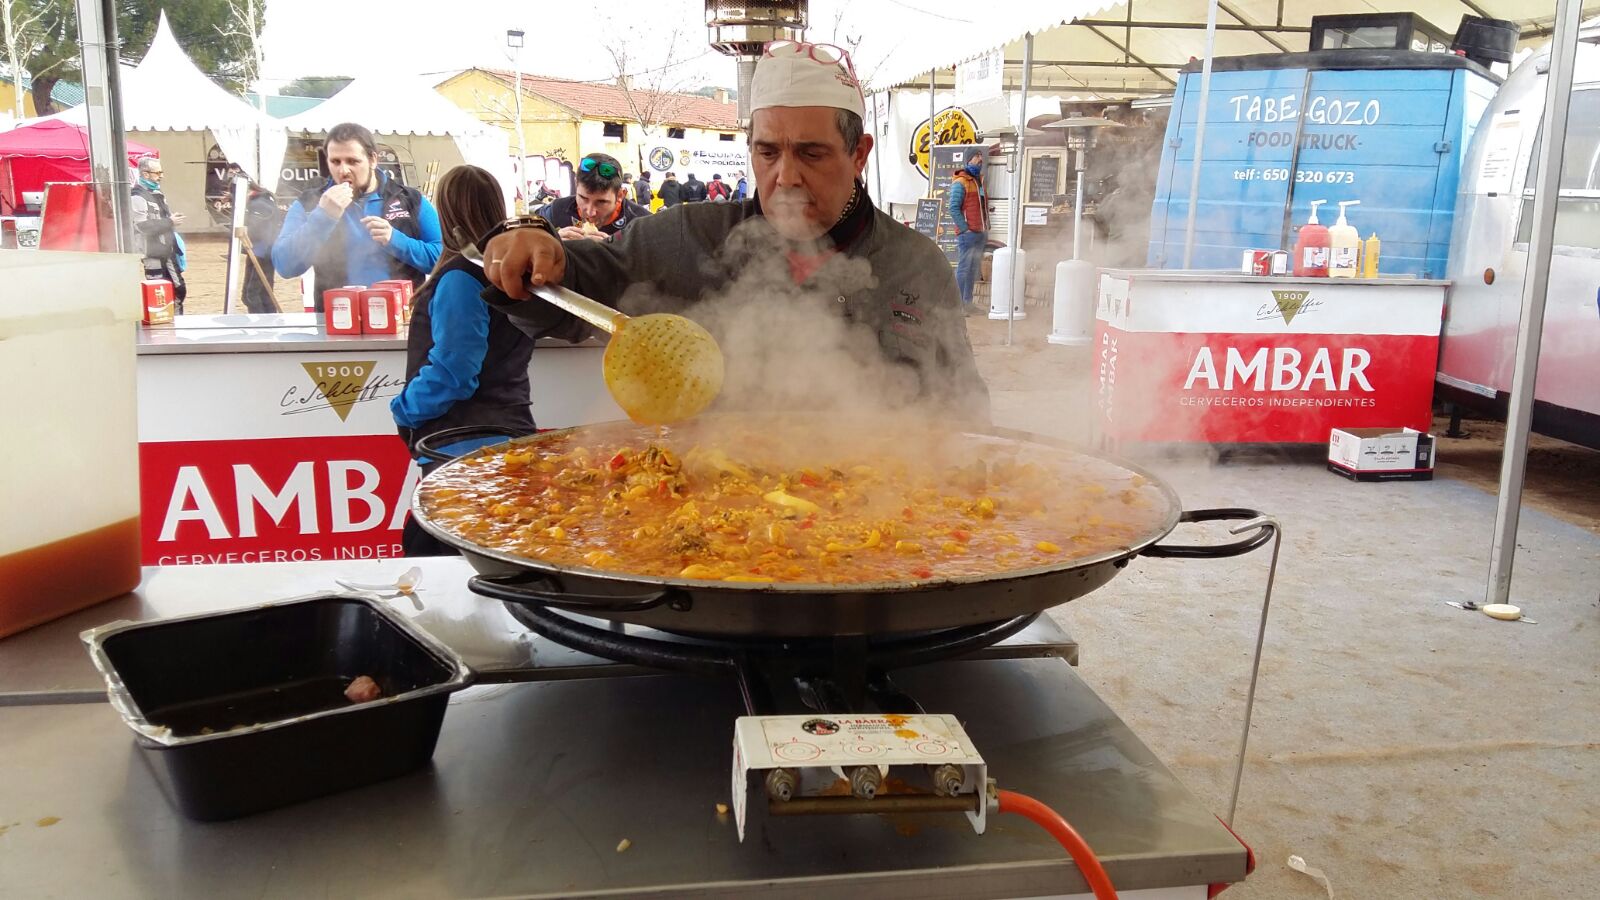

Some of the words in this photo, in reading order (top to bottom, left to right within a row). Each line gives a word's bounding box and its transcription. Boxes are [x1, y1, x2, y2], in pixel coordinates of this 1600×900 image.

[1248, 132, 1292, 147] FOOD
[1302, 134, 1357, 150] TRUCK
[1263, 168, 1288, 181] 650
[1296, 170, 1323, 183] 320
[1326, 171, 1354, 184] 673
[316, 365, 364, 378] 1900
[1184, 346, 1375, 392] AMBAR
[1181, 397, 1264, 408] CERVECEROS
[1269, 398, 1376, 408] INDEPENDIENTES
